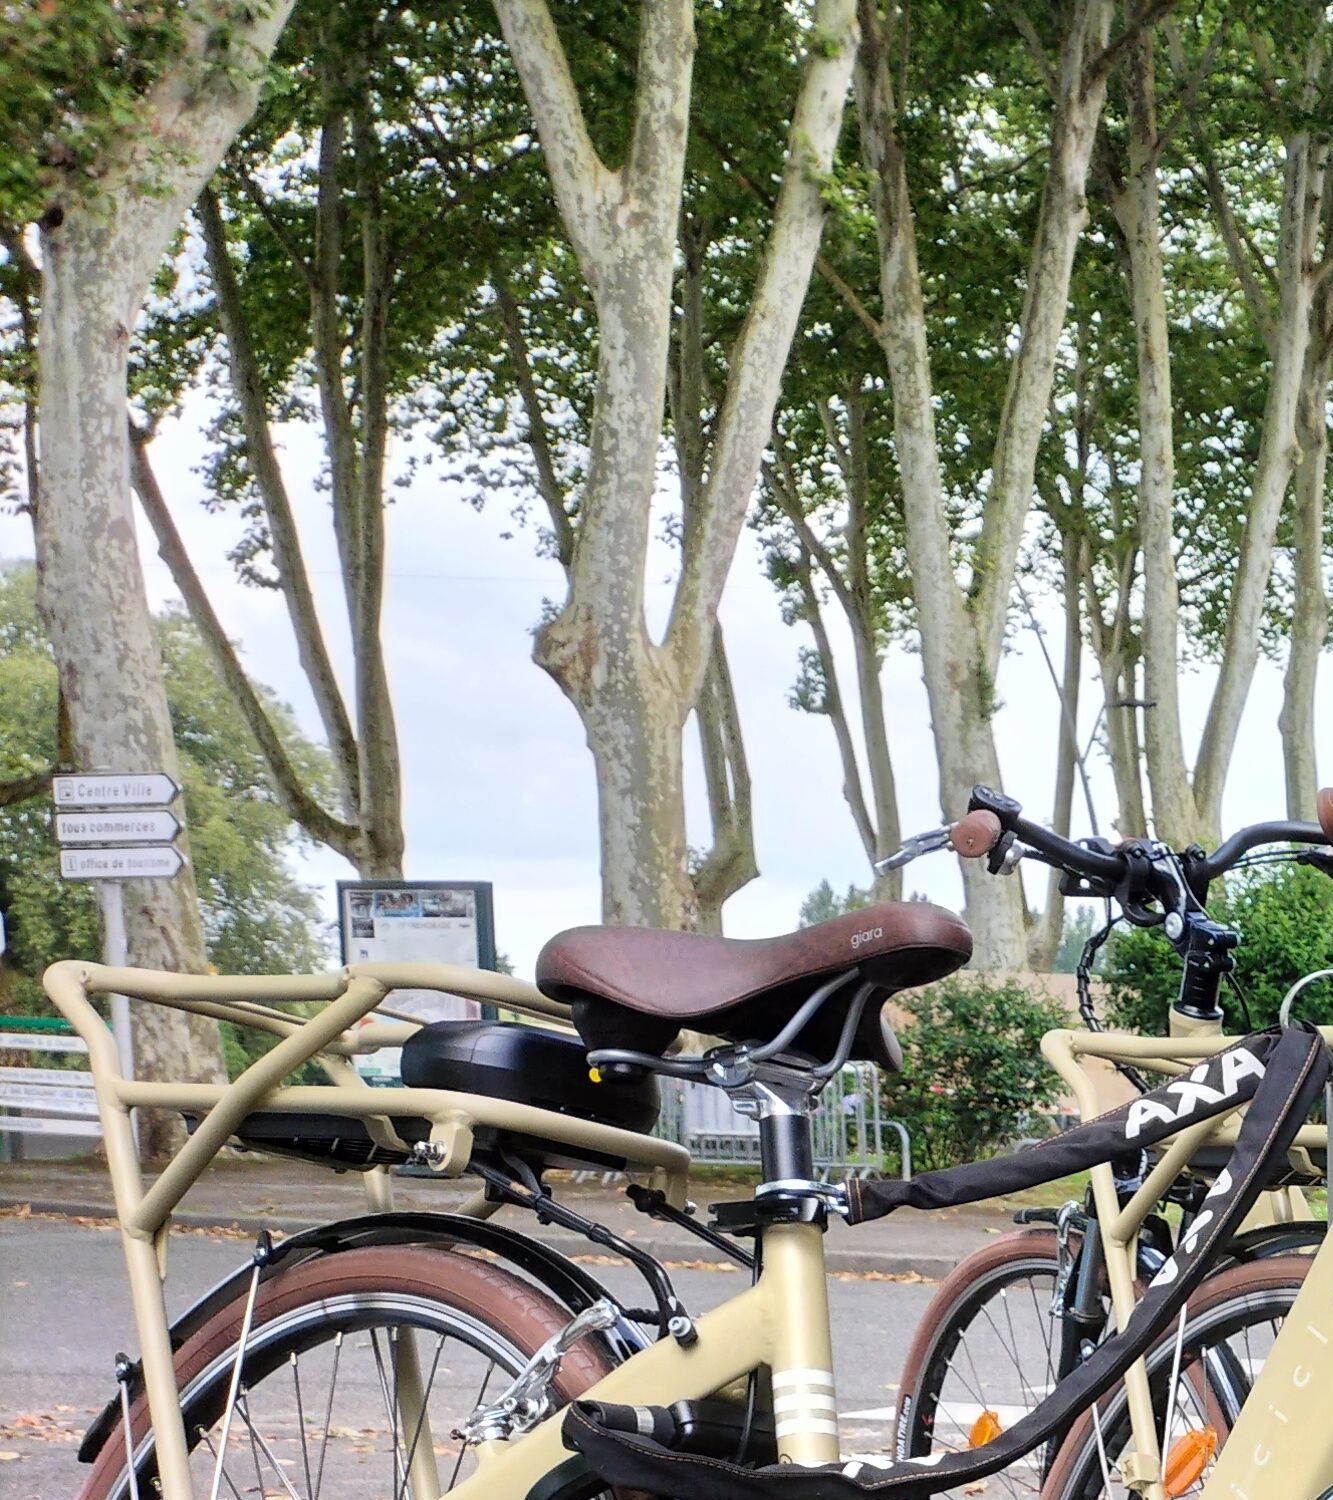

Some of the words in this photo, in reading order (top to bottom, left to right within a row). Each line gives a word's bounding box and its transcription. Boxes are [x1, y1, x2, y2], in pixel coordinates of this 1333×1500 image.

[77, 783, 119, 797] Centre
[122, 783, 152, 797] Ville
[61, 821, 86, 834] tous
[89, 821, 156, 833] commerces
[80, 858, 109, 869] office
[112, 858, 124, 869] de
[851, 927, 883, 949] giara
[1125, 1047, 1266, 1139] AXA
